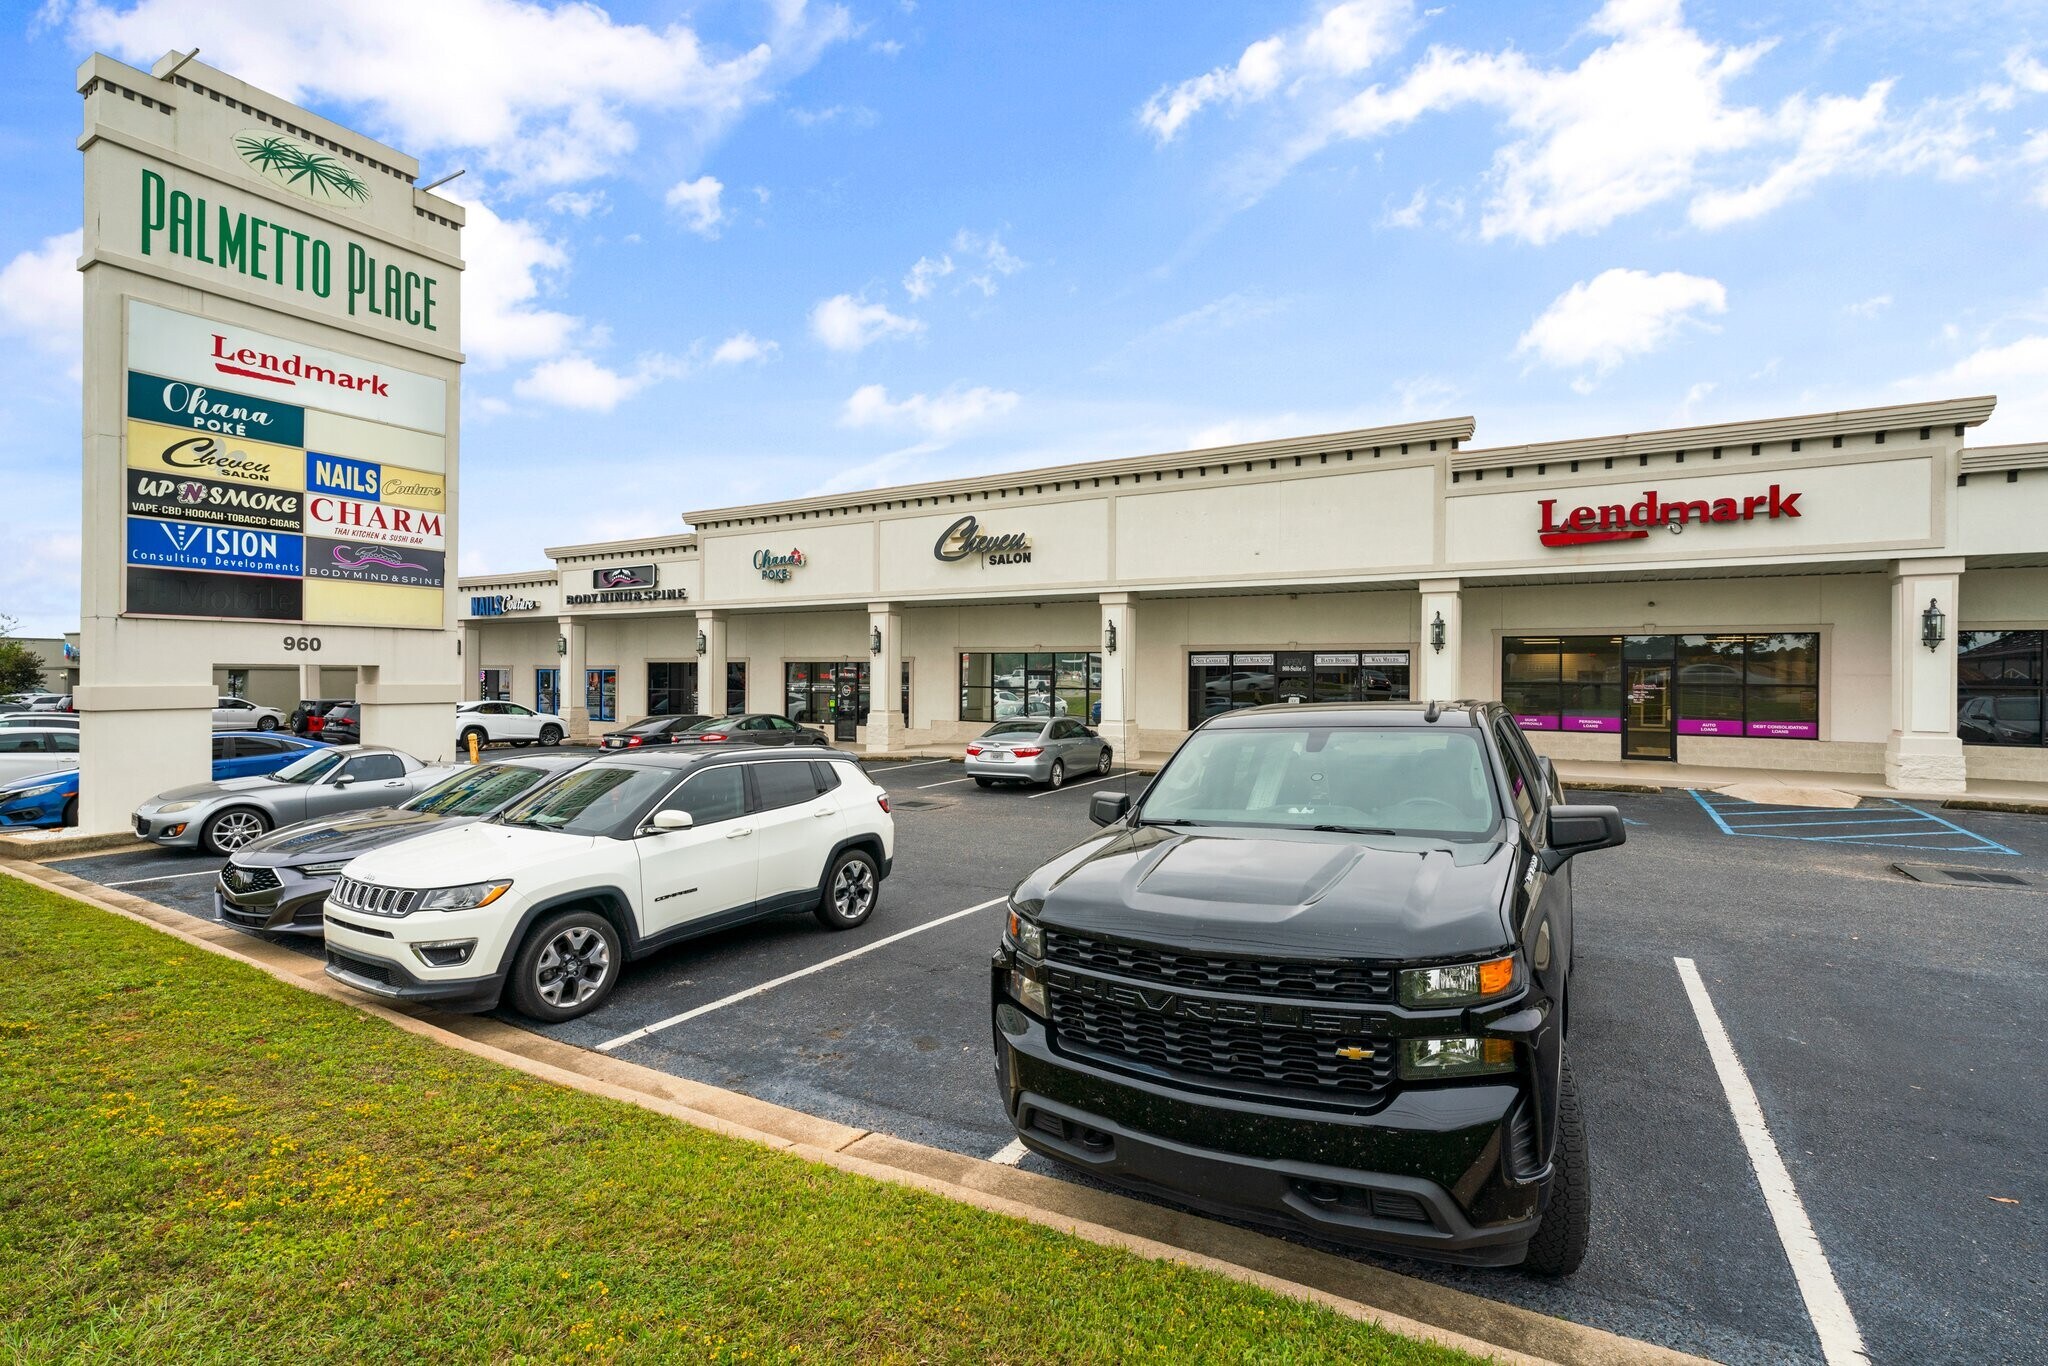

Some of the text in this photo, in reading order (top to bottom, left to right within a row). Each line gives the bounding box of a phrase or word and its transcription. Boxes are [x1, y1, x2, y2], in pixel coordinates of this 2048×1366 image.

[141, 168, 437, 332] PALMETTO PLACE
[211, 333, 389, 397] Lendmark
[162, 382, 274, 426] Ohana
[193, 416, 246, 436] POKÉ
[161, 437, 271, 473] Cheveu
[221, 469, 269, 481] SALON
[315, 460, 441, 496] NAILS Couture
[137, 477, 297, 513] UP N SMOKE
[1537, 484, 1802, 533] Lendmark
[310, 497, 443, 537] CHARM
[159, 522, 277, 559] VISION
[334, 527, 350, 536] THAI
[351, 530, 380, 540] KITCHEN
[389, 534, 408, 543] SUSHI
[409, 537, 423, 545] BAR
[933, 515, 1027, 562] Cheveu
[132, 549, 300, 572] Consulting Developments
[753, 549, 800, 569] Ohana
[989, 552, 1032, 565] SALON
[471, 595, 536, 616] NAILS Couture
[566, 593, 598, 605] BODY
[283, 636, 321, 651] 960
[1047, 970, 1388, 1034] CHEVROLET
